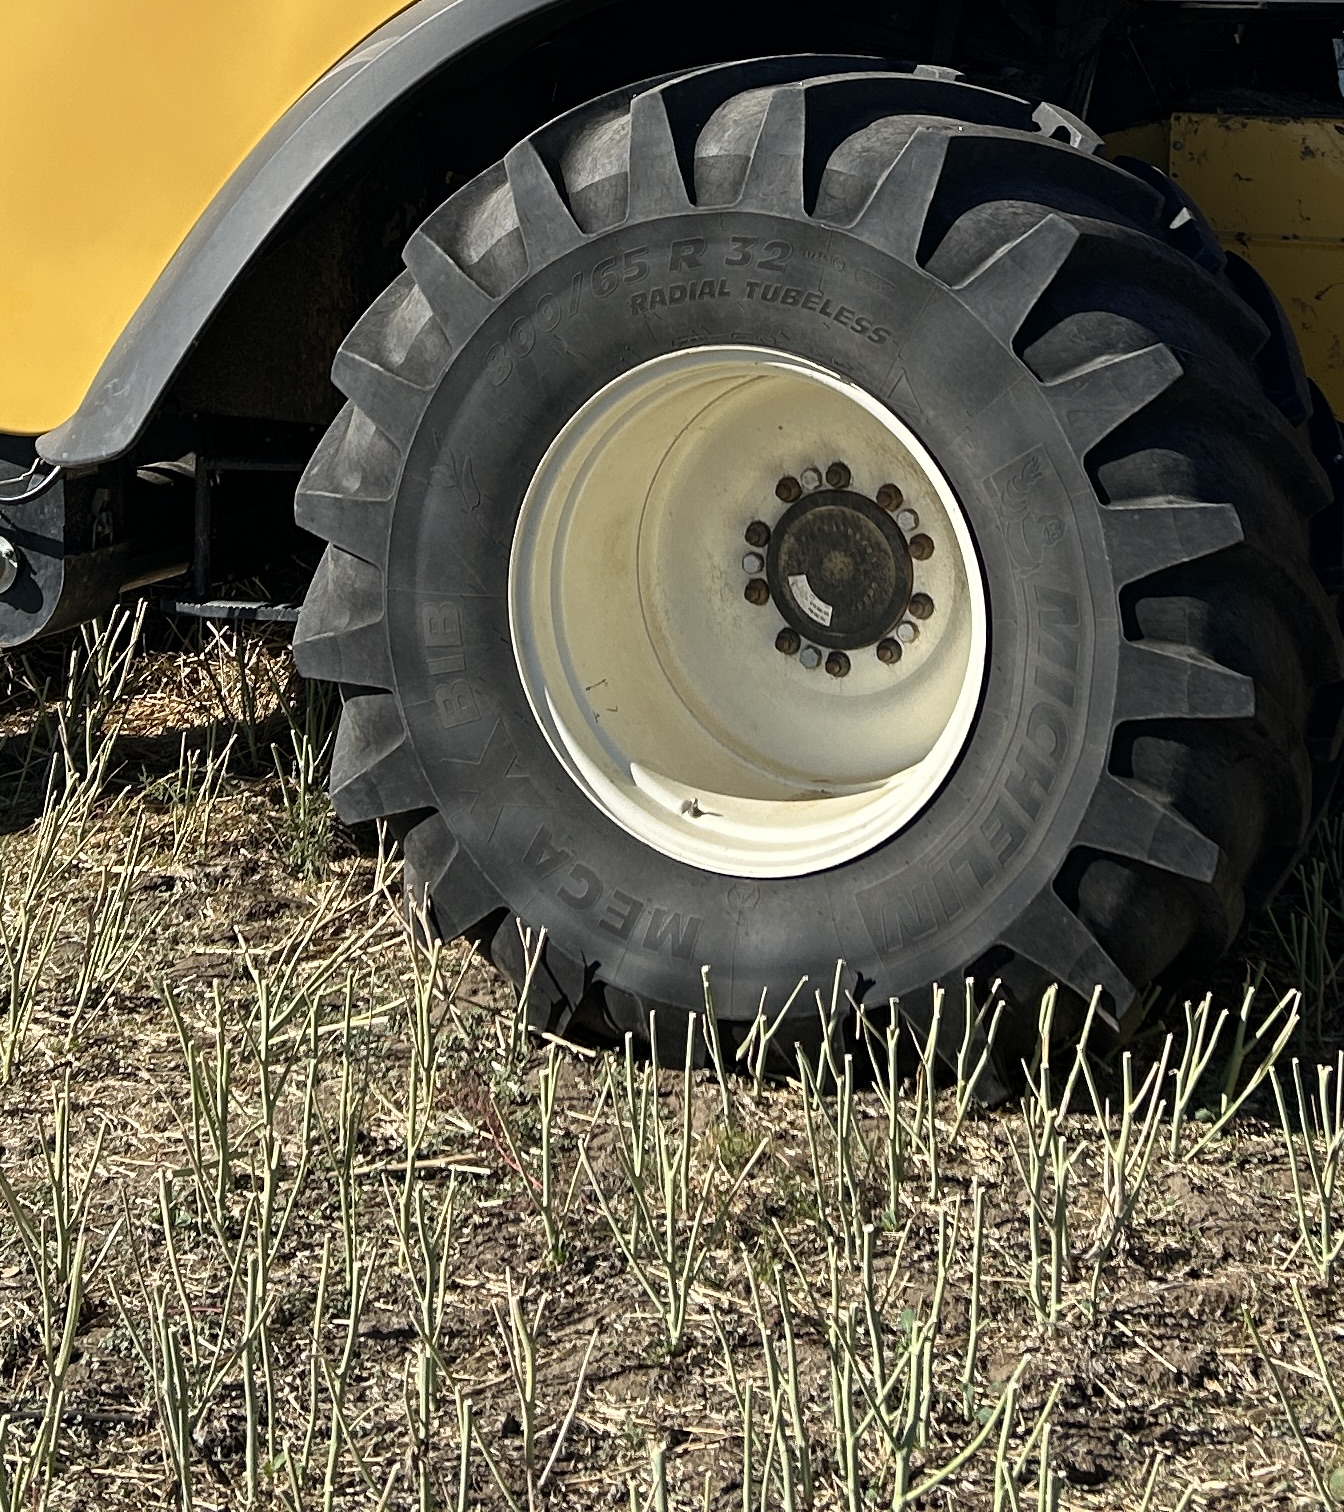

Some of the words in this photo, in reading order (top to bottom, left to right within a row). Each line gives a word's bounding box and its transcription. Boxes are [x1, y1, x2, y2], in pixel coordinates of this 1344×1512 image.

[668, 236, 708, 273] R
[723, 236, 794, 274] 32
[628, 277, 732, 318] RADIAL
[745, 280, 894, 346] TUBELESS
[880, 584, 1081, 954] MICHELIN
[521, 823, 704, 963] MEGA
